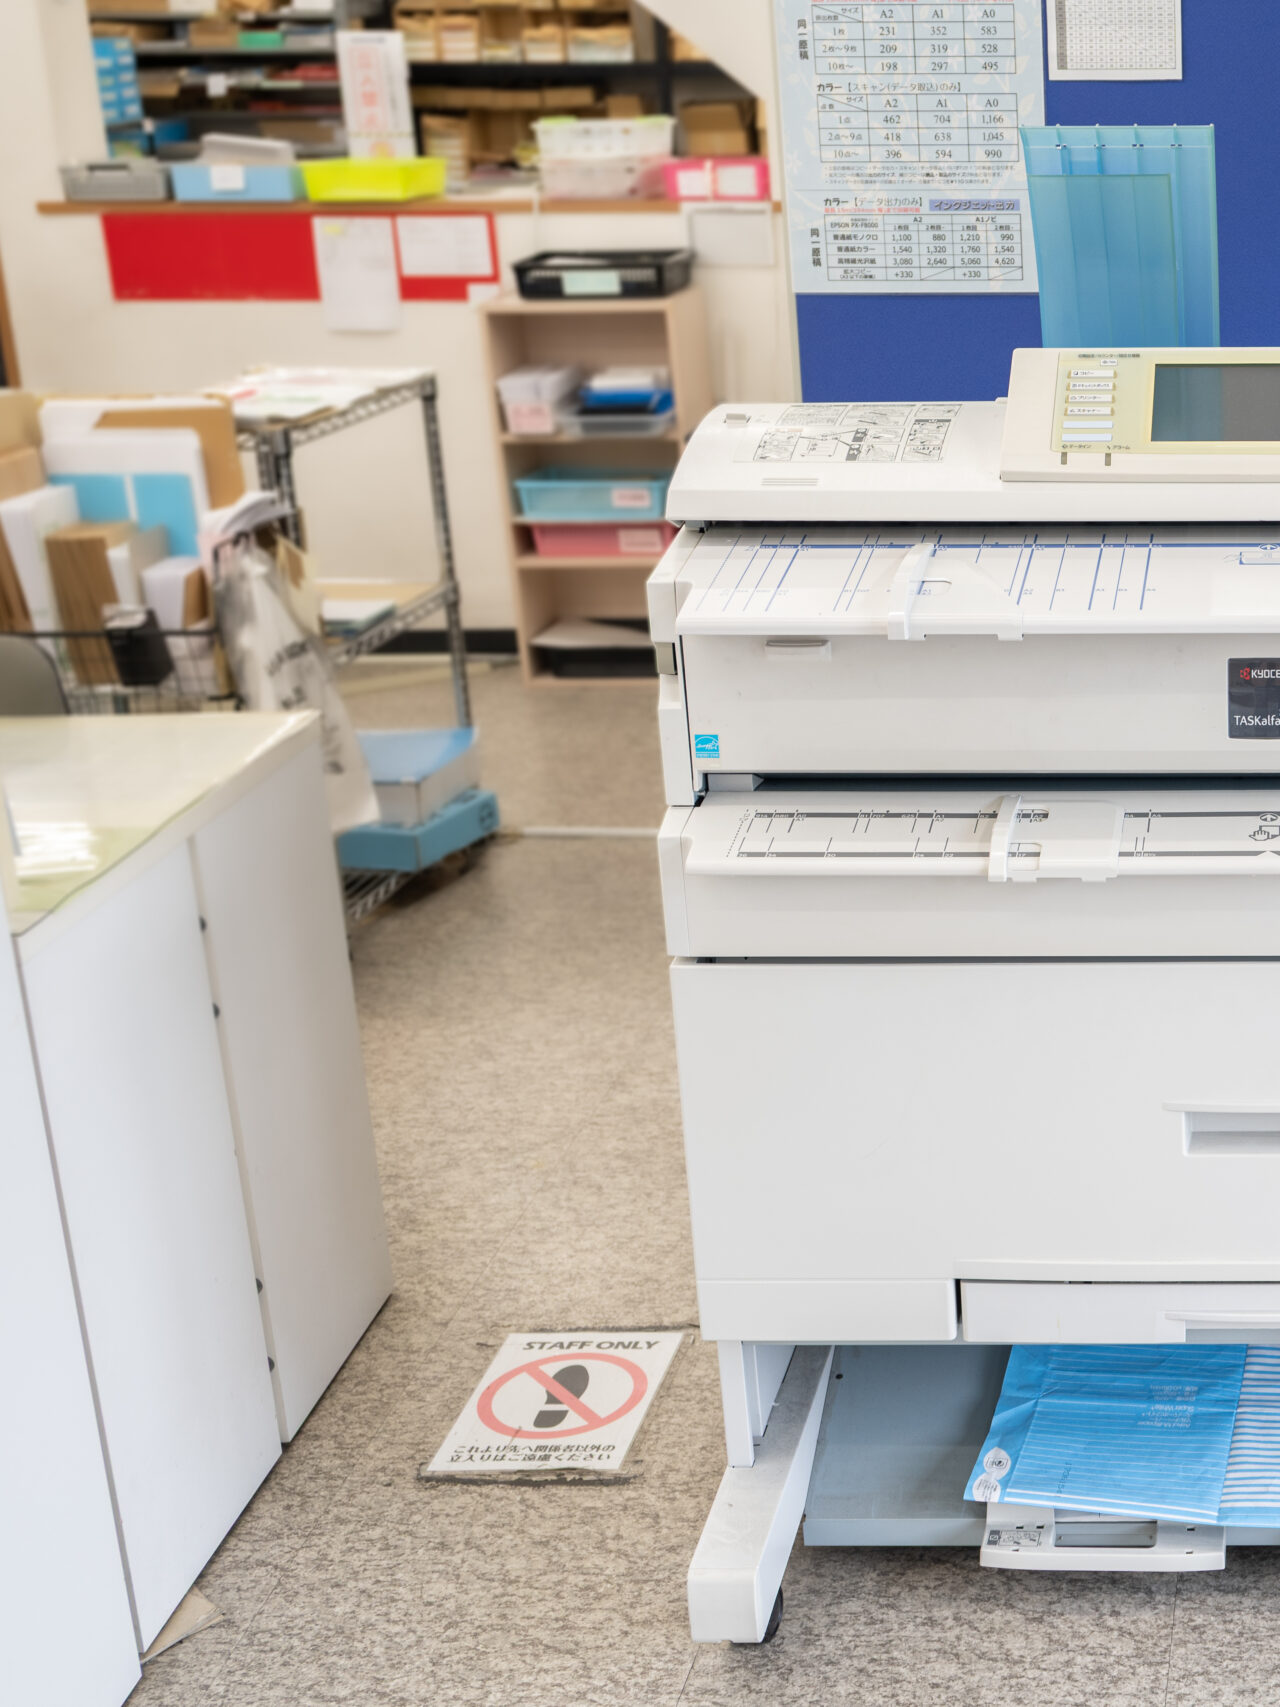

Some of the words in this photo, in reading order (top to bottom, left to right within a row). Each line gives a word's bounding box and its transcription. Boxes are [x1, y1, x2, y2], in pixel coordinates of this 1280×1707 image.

[880, 9, 894, 18] A2
[932, 9, 944, 18] A1
[981, 9, 996, 18] A0
[879, 27, 896, 36] 231
[930, 27, 947, 36] 352
[981, 27, 998, 36] 583
[880, 44, 897, 54] 209
[931, 44, 948, 54] 319
[981, 44, 999, 54] 528
[880, 62, 898, 72] 198
[931, 62, 949, 72] 297
[981, 62, 999, 72] 495
[884, 99, 898, 108] A2
[936, 99, 948, 108] A1
[985, 99, 999, 108] A0
[883, 115, 901, 125] 462
[934, 115, 951, 125] 704
[981, 115, 1004, 125] 1,166
[883, 132, 901, 142] 418
[934, 132, 951, 142] 638
[982, 132, 1004, 142] 1,045
[885, 149, 902, 159] 396
[935, 149, 952, 159] 594
[984, 149, 1002, 159] 990
[892, 234, 912, 242] 1,100
[960, 234, 981, 242] 1,210
[892, 246, 912, 254] 1,540
[926, 246, 947, 254] 1,320
[960, 246, 981, 254] 1,760
[995, 246, 1014, 254] 1,540
[892, 258, 913, 266] 3,080
[927, 258, 947, 266] 2,640
[961, 258, 981, 266] 5,060
[995, 258, 1015, 266] 4,620
[894, 270, 913, 279] +330
[962, 270, 981, 279] +330
[1234, 715, 1280, 726] TASKalfa
[522, 1341, 594, 1350] STAFF
[595, 1341, 661, 1350] ONLY
[454, 1444, 616, 1454] これより先へ関係者以外の
[449, 1454, 611, 1462] 立入りはご遠慮ください
